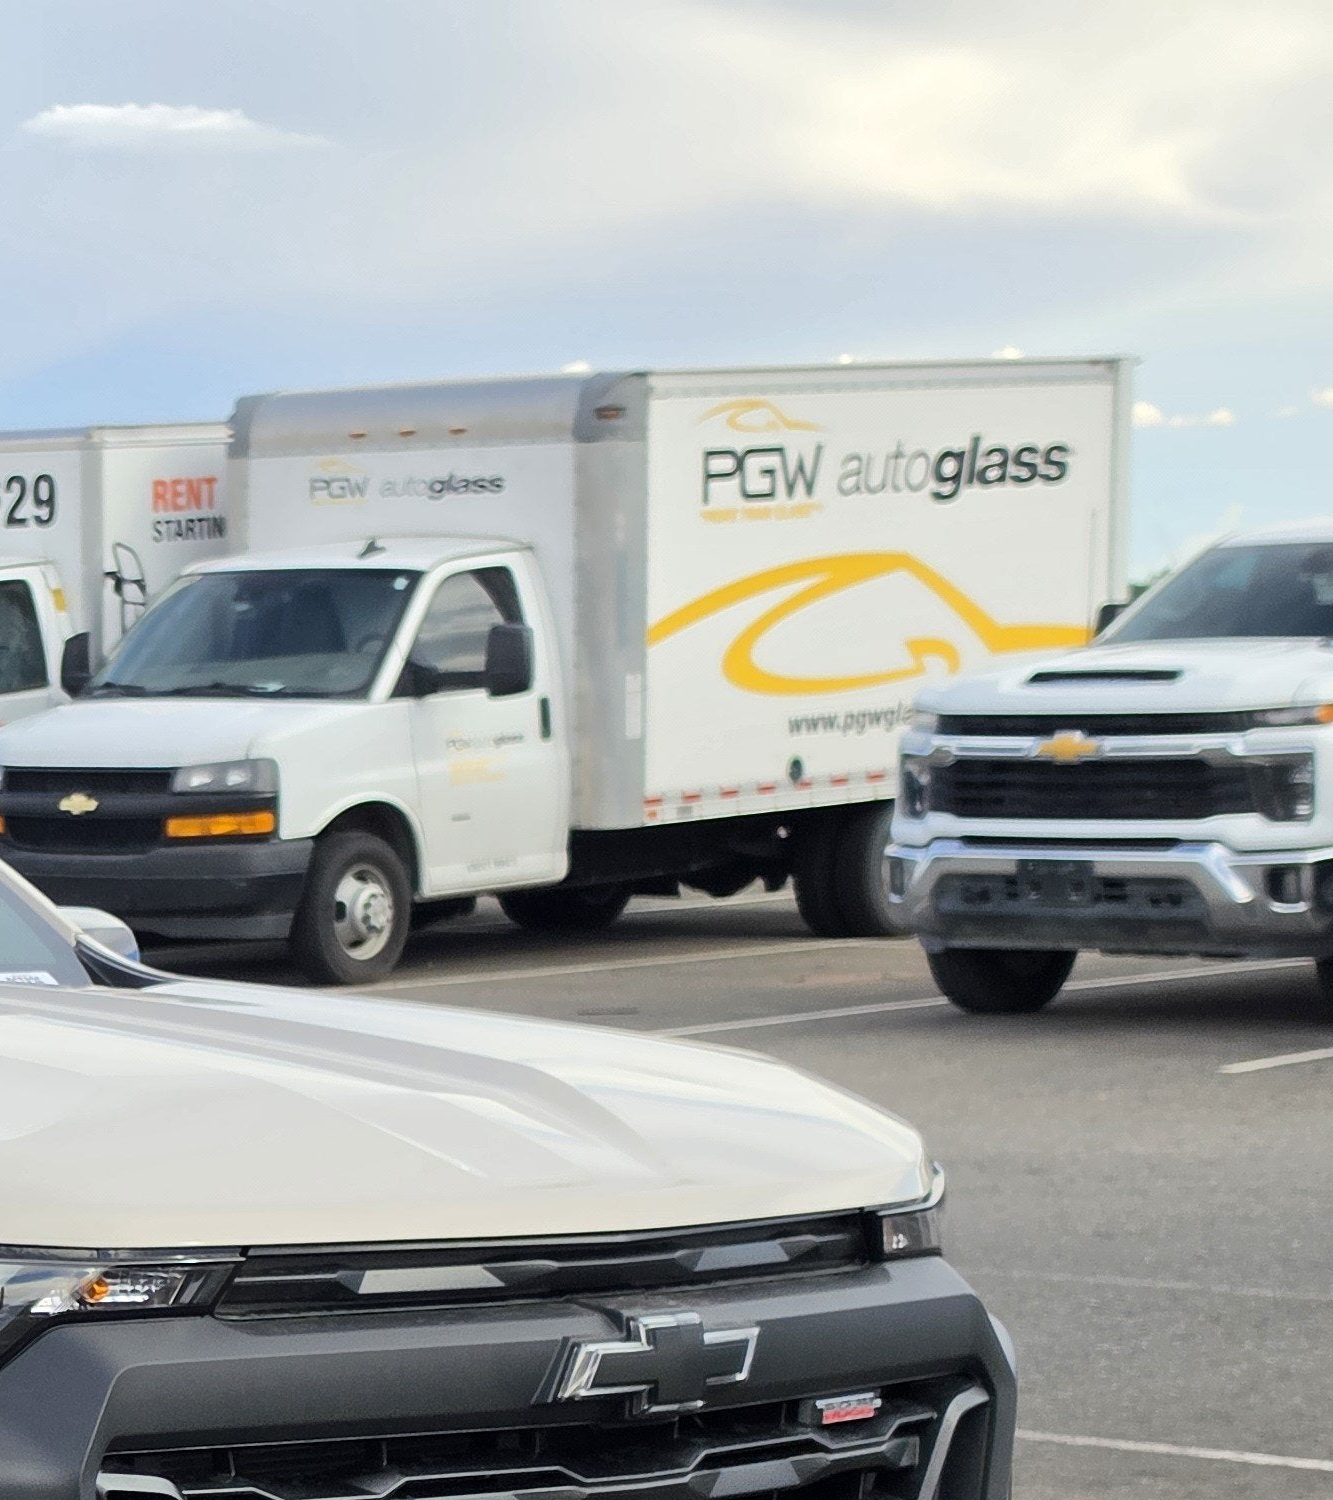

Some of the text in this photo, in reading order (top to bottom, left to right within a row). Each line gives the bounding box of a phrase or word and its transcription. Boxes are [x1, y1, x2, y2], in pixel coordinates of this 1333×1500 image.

[702, 433, 1071, 504] PGW autoglass
[153, 476, 218, 512] RENT
[309, 477, 369, 499] PGW
